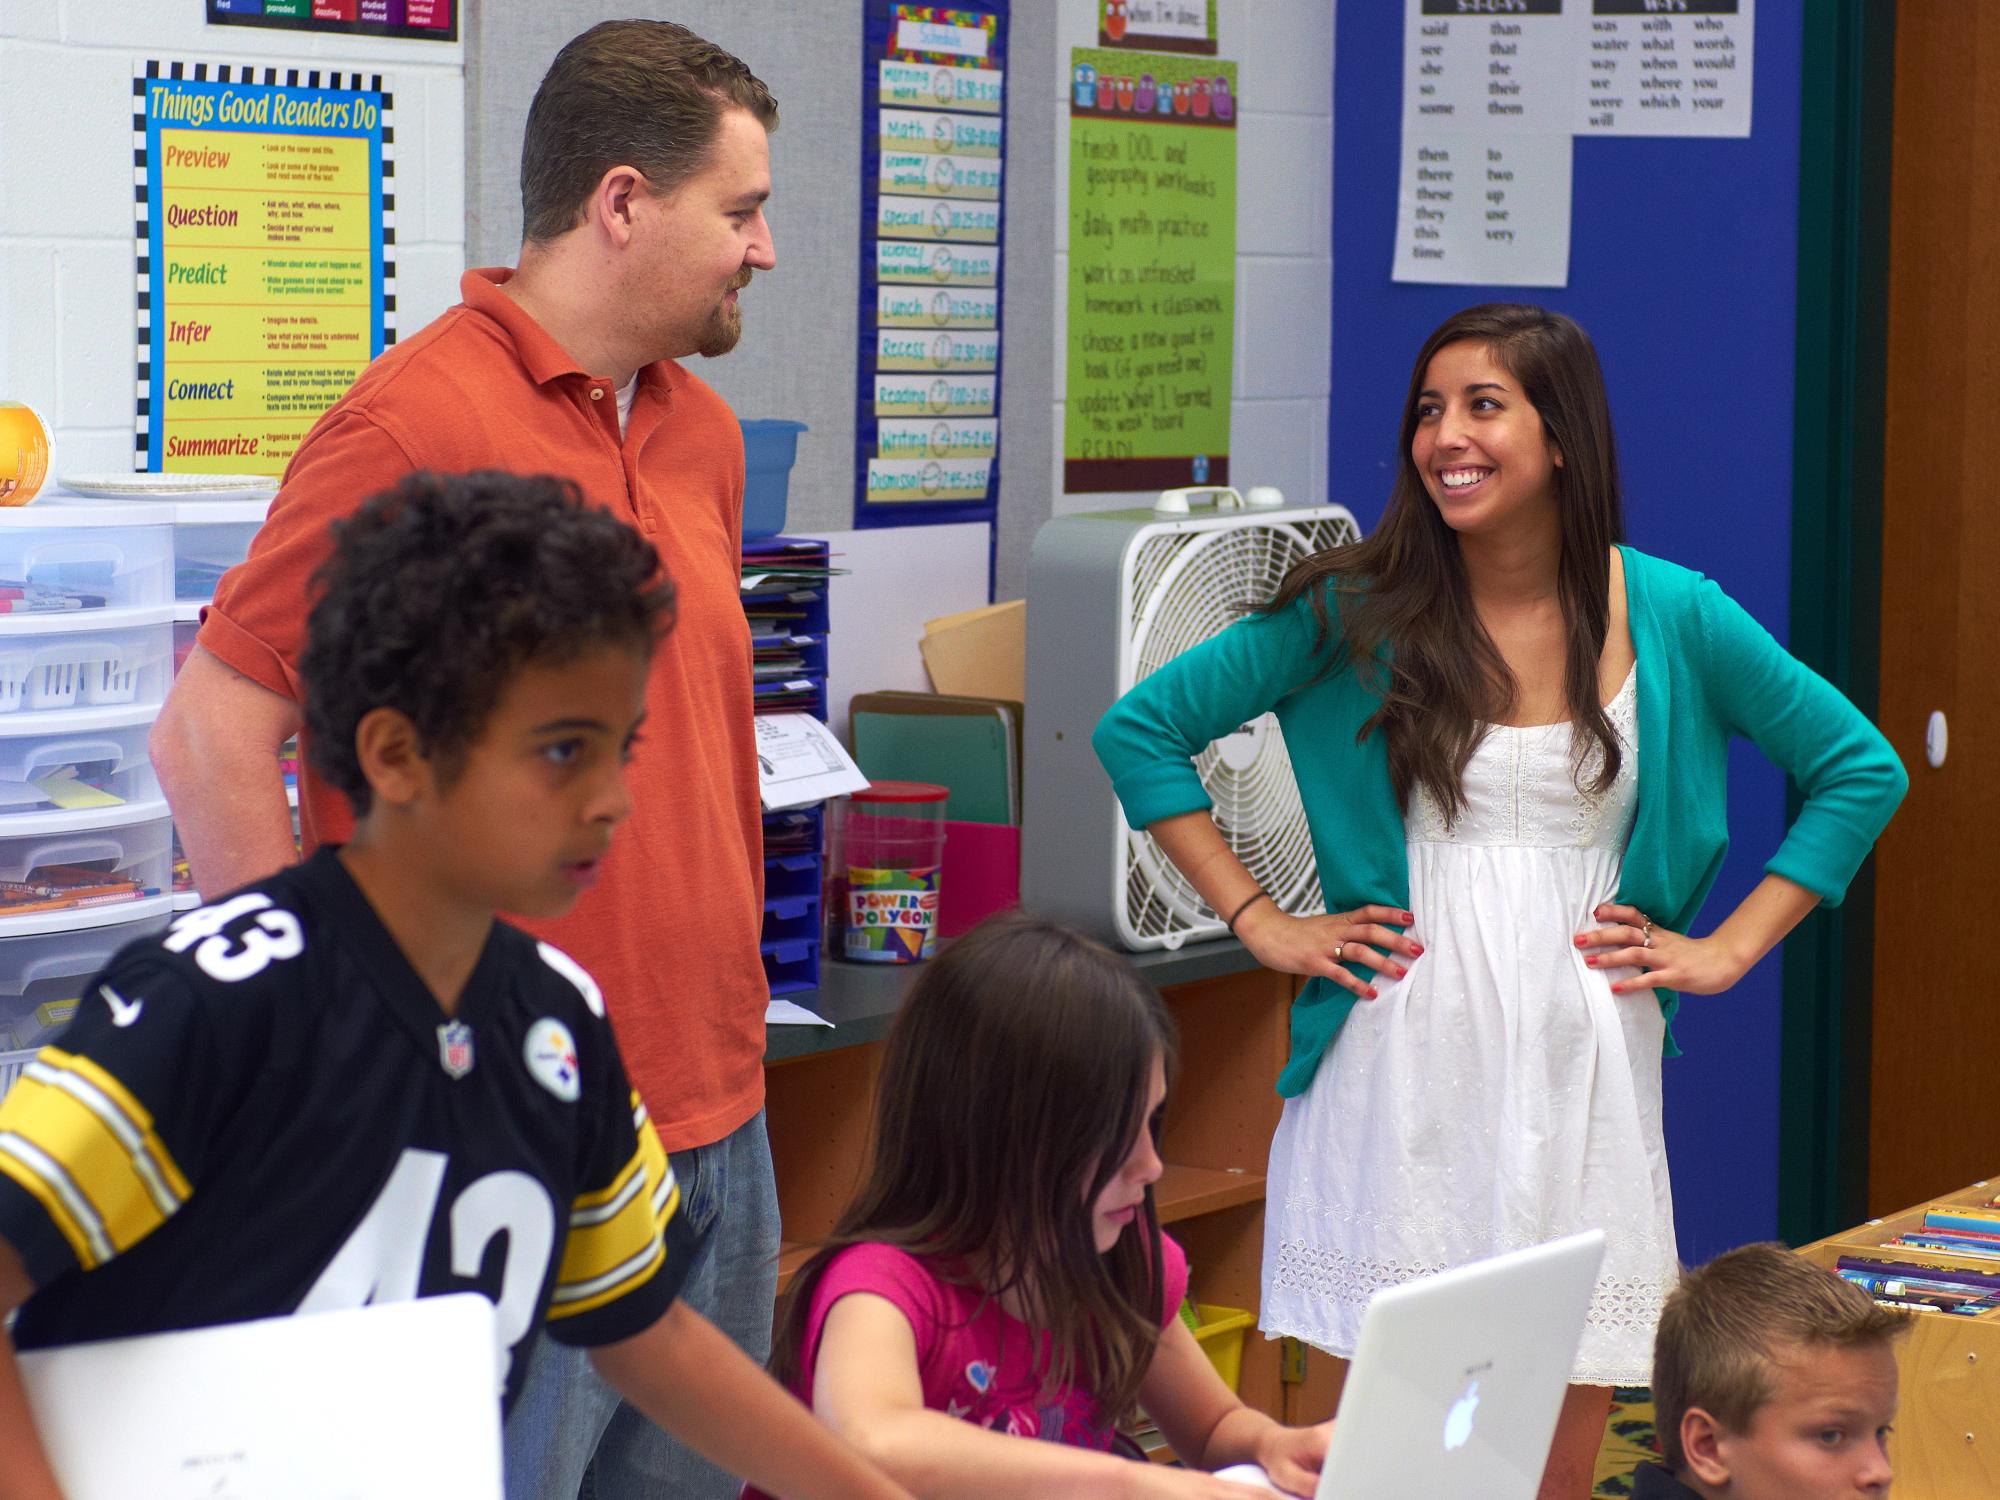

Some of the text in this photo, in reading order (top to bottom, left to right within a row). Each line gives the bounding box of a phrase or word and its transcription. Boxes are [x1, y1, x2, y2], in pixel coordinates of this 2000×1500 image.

[1422, 22, 1448, 35] said
[1490, 22, 1521, 35] than
[1592, 21, 1617, 32] was
[1642, 17, 1672, 32] with
[1694, 16, 1723, 30] who
[1490, 42, 1517, 55] that
[1592, 39, 1629, 50] water
[1642, 36, 1674, 50] what
[1421, 62, 1442, 75] she
[1489, 62, 1511, 75] the
[1592, 60, 1616, 73] way
[1641, 56, 1677, 70] when
[1693, 55, 1735, 69] would
[1489, 82, 1520, 94] their
[1640, 76, 1682, 89] where
[1692, 79, 1717, 91] you
[152, 86, 376, 130] Things Good Readers Do
[1488, 100, 1523, 114] them
[1590, 98, 1623, 108] were
[1640, 94, 1680, 108] which
[1692, 98, 1723, 112] your
[1420, 104, 1454, 114] some
[1590, 114, 1614, 127] will
[888, 121, 926, 139] Math
[166, 146, 230, 168] Preview
[1165, 140, 1186, 164] and
[1418, 146, 1449, 161] then
[1487, 148, 1502, 161] to
[1417, 167, 1453, 181] there
[1487, 169, 1514, 181] two
[1088, 167, 1148, 196] geography
[1417, 187, 1453, 200] these
[1486, 191, 1504, 204] up
[168, 204, 238, 228] Question
[1416, 206, 1444, 224] they
[1486, 210, 1509, 221] use
[1120, 210, 1153, 235] math
[1158, 213, 1209, 247] practice
[1414, 226, 1439, 240] this
[1486, 230, 1514, 244] very
[1413, 245, 1445, 259] time
[168, 262, 228, 284] Predict
[1084, 263, 1115, 284] work
[884, 296, 922, 318] Lunch
[1084, 292, 1144, 315] homework
[168, 321, 211, 345] Infer
[1082, 330, 1124, 352] choose
[1131, 334, 1138, 350] a
[1142, 331, 1168, 348] new
[883, 338, 926, 360] Recess
[1085, 359, 1109, 379] book
[168, 379, 234, 400] Connect
[311, 379, 332, 387] thoughts
[306, 394, 322, 402] you've
[880, 386, 926, 411] Reading
[267, 433, 289, 442] Organize
[167, 434, 258, 458] Summarize
[881, 432, 927, 458] Writing
[870, 468, 921, 492] Dismissal
[856, 892, 919, 910] POWER
[164, 894, 304, 982] 43
